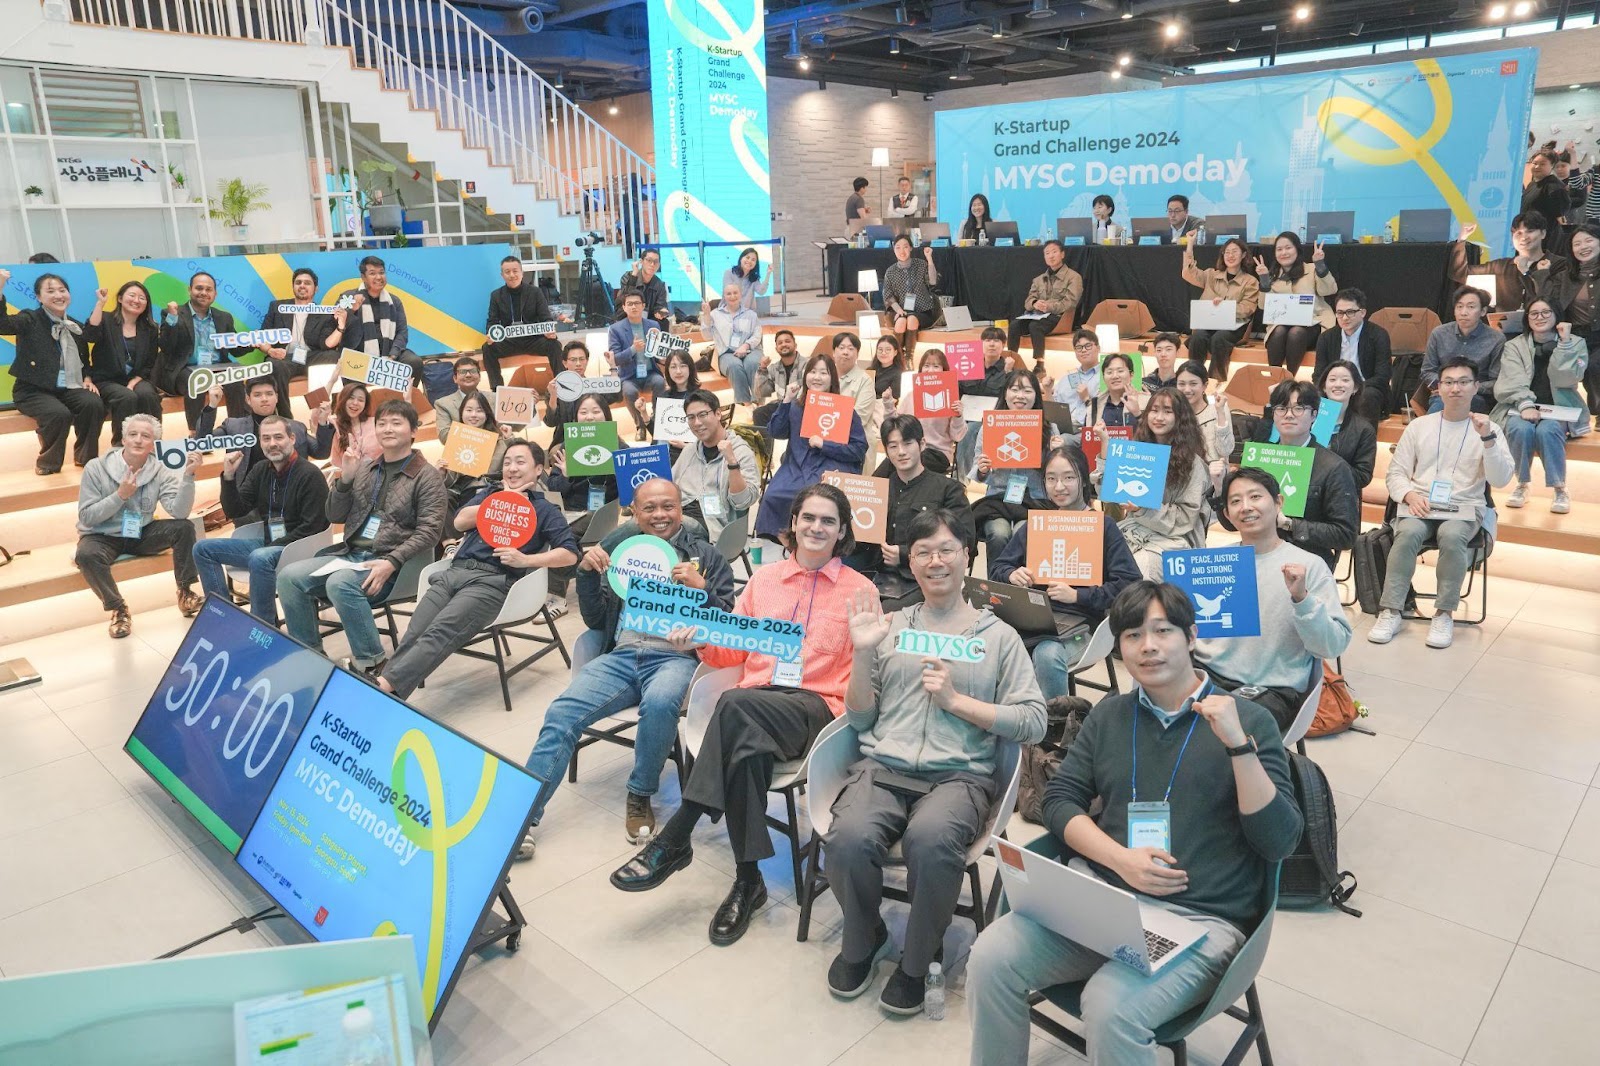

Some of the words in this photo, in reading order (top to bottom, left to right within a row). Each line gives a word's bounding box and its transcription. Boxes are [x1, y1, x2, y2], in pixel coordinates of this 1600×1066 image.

[707, 45, 743, 58] K-Startup
[708, 57, 731, 67] Grand
[708, 69, 746, 81] Challenge
[1470, 66, 1496, 77] mysc
[709, 81, 727, 89] 2024
[709, 93, 739, 106] MYSC
[709, 105, 758, 120] Demoday
[994, 117, 1070, 136] K-Startup
[994, 140, 1041, 157] Grand
[1045, 136, 1131, 155] Challenge
[1135, 130, 1180, 149] 2024
[60, 165, 144, 182] 상상플래닛
[994, 162, 1076, 191] MYSC
[1086, 153, 1249, 188] Demoday
[388, 263, 435, 293] Demoday
[506, 326, 525, 337] OPEN
[526, 323, 555, 335] ENERGY
[211, 330, 292, 348] TECHUB
[661, 333, 691, 352] Flying
[947, 345, 955, 354] 10
[371, 356, 412, 377] TASTED
[215, 362, 273, 386] plana
[367, 370, 409, 392] BETTER
[915, 376, 921, 386] 4
[809, 394, 816, 404] 5
[987, 414, 994, 427] 9
[567, 426, 578, 438] 13
[1085, 431, 1091, 441] 8
[184, 433, 256, 452] balance
[1111, 443, 1123, 457] 14
[1247, 447, 1256, 461] 3
[1261, 448, 1275, 456] GOOD
[1276, 450, 1296, 458] HEALTH
[615, 454, 626, 466] 17
[828, 476, 841, 488] 12
[491, 499, 517, 513] PEOPLE
[485, 508, 529, 528] BUSINESS
[1031, 516, 1044, 531] 11
[490, 524, 511, 537] FORCE
[493, 535, 511, 546] GOOD
[626, 558, 663, 572] SOCIAL
[1190, 555, 1213, 565] PEACE,
[1214, 553, 1240, 564] JUSTICE
[1166, 556, 1186, 577] 16
[1191, 566, 1205, 575] AND
[1206, 564, 1233, 574] STRONG
[1192, 575, 1236, 585] INSTITUTIONS
[630, 578, 706, 603] K-Startup
[627, 596, 675, 615] Grand
[680, 605, 760, 630] Challenge
[763, 619, 803, 637] 2024
[249, 627, 274, 650] 현재시간
[693, 624, 800, 661] Demoday
[899, 630, 984, 660] mysc
[165, 637, 295, 778] 50:00
[321, 711, 373, 755] K-Startup
[310, 734, 341, 767] Grand
[342, 756, 399, 805] Challenge
[398, 794, 432, 828] 2024
[294, 757, 341, 803] MYSC
[336, 788, 422, 867] Demoday
